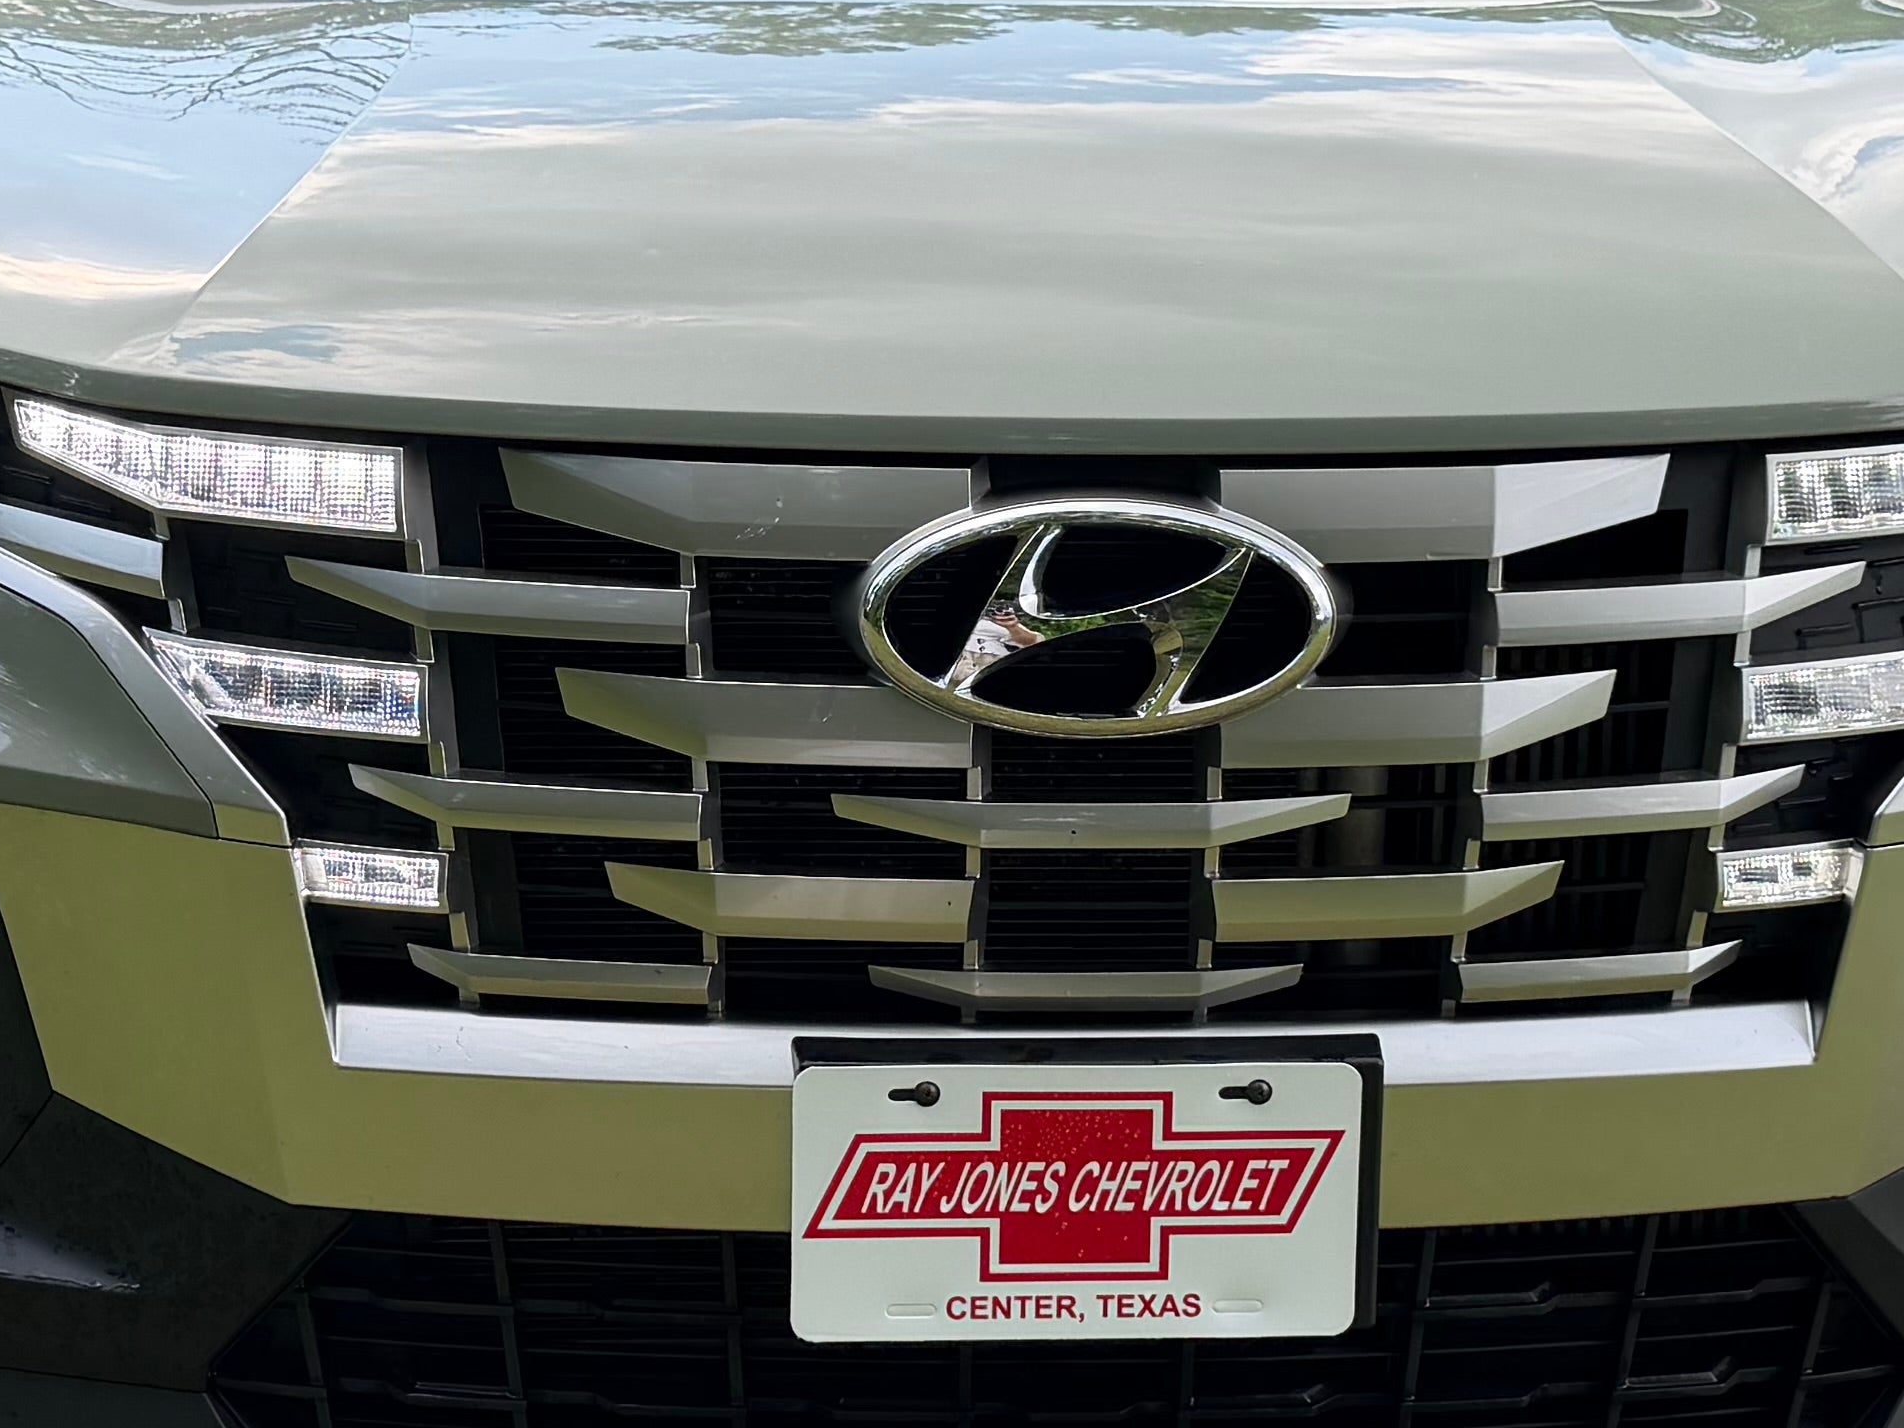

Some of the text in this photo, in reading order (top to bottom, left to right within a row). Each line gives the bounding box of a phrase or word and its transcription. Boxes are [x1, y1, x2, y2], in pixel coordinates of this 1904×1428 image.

[860, 1158, 1291, 1214] RAY JONES CHEVROLET
[945, 1292, 1202, 1323] CENTER, TEXAS
